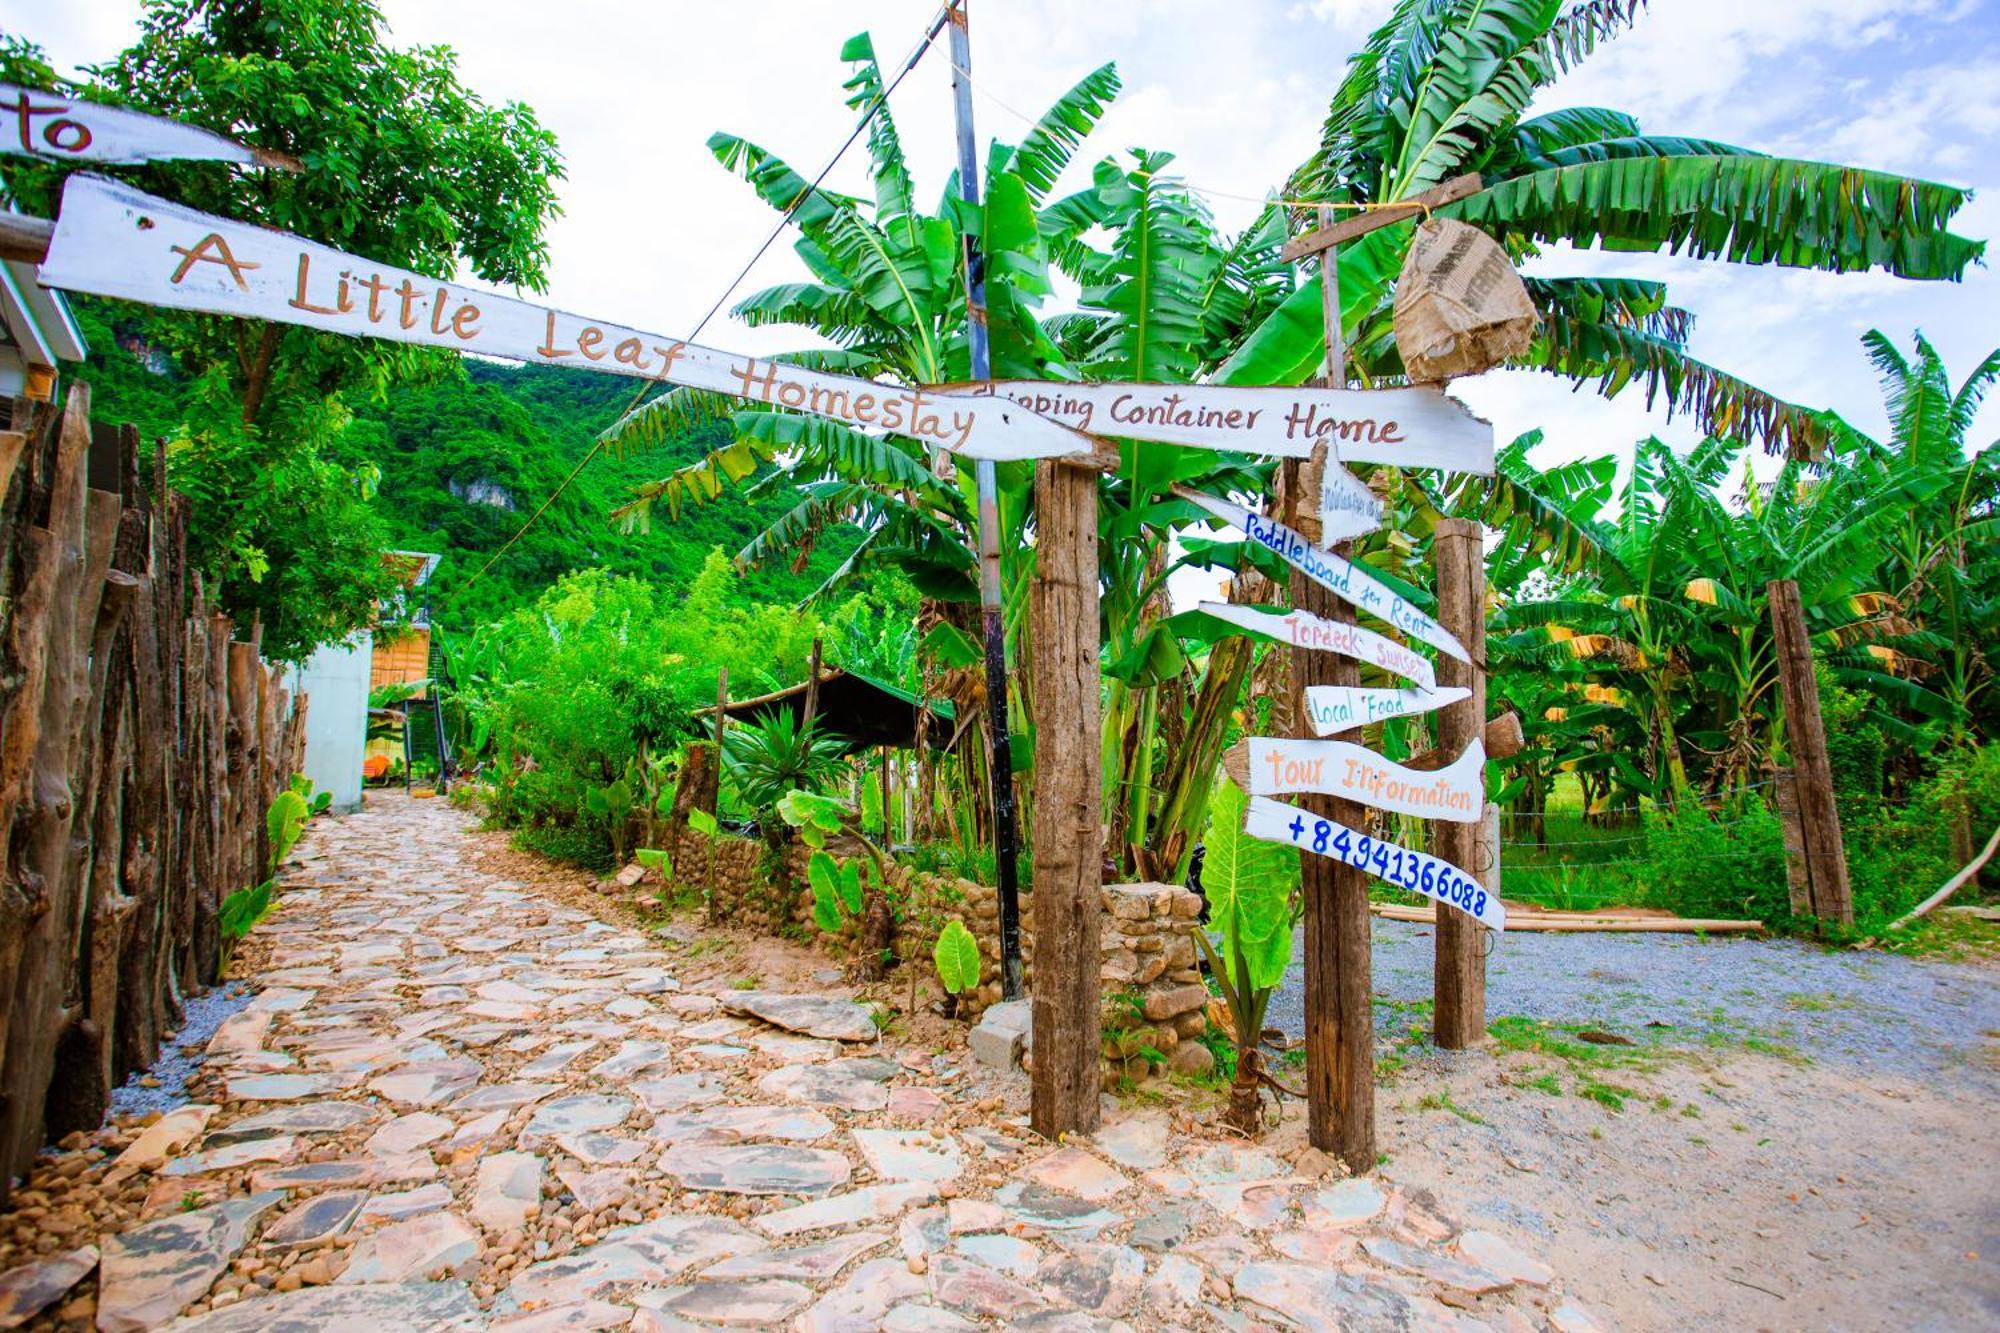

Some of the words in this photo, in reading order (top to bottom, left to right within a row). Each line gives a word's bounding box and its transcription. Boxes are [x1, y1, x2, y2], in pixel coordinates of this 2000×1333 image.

[170, 232, 262, 293] A
[287, 252, 484, 339] Little
[537, 309, 686, 380] Leaf
[731, 357, 976, 452] Homestay
[1109, 394, 1265, 430] Container
[1285, 402, 1408, 444] Home
[1245, 513, 1351, 594] Paddleboard
[1390, 596, 1433, 638] Rent
[1312, 690, 1353, 725] Local
[1366, 694, 1405, 715] Food
[1343, 758, 1473, 812] Information
[1288, 814, 1488, 918] +84941366088
